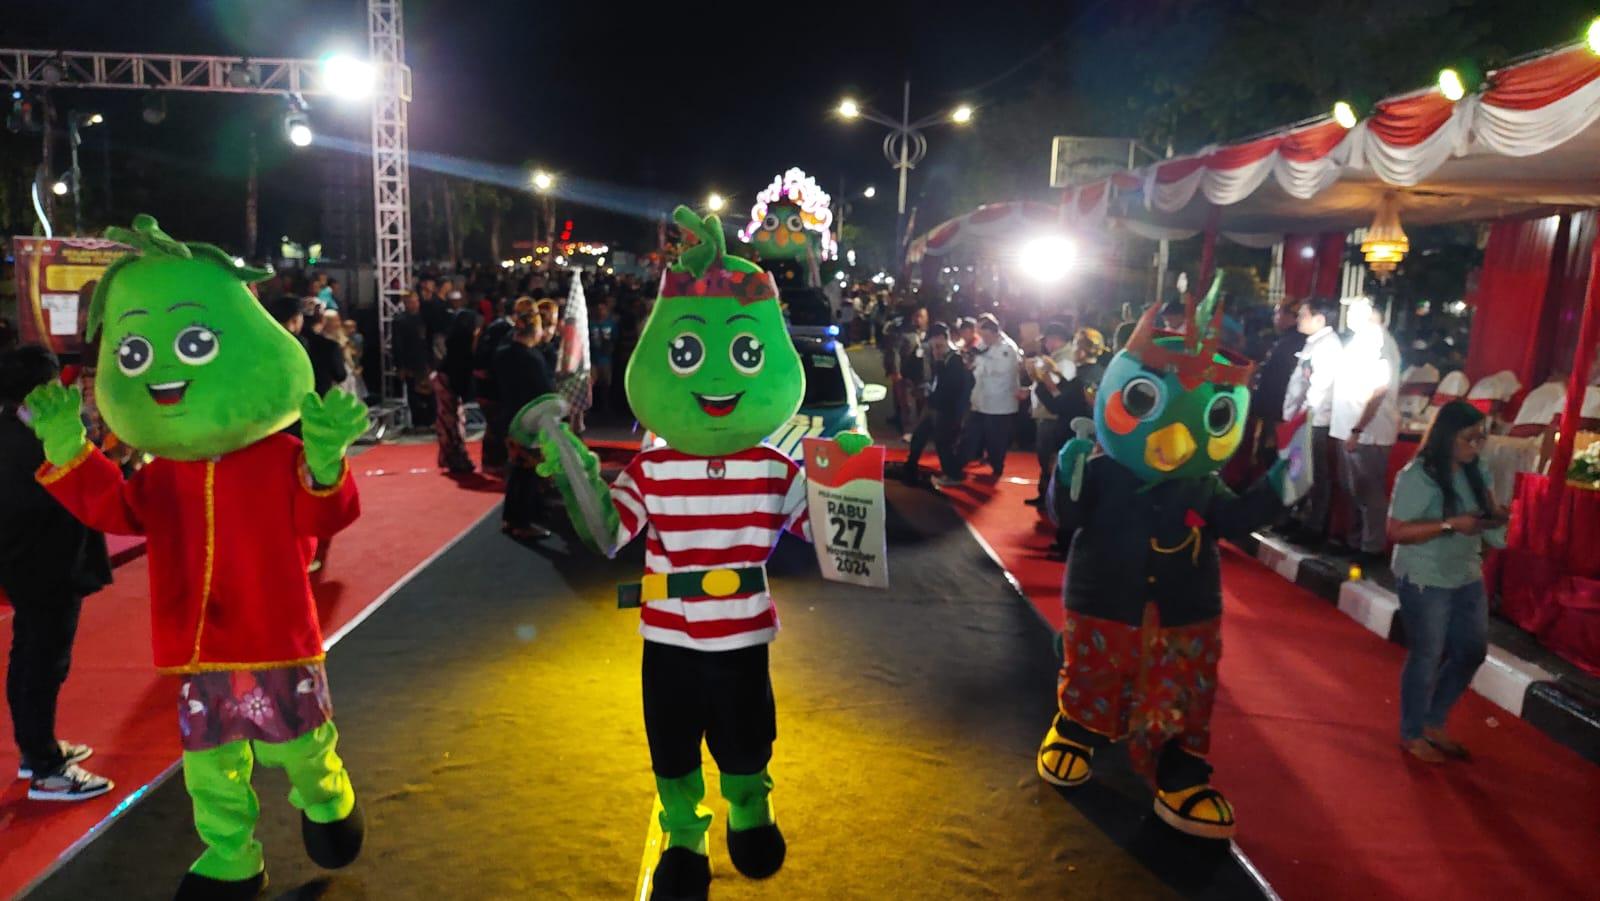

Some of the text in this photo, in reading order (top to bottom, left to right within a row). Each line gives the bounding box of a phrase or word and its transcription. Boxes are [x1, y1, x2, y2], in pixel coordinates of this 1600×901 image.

[828, 501, 867, 519] RABU
[831, 517, 866, 550] 27
[826, 545, 876, 563] November
[835, 556, 870, 577] 2024
